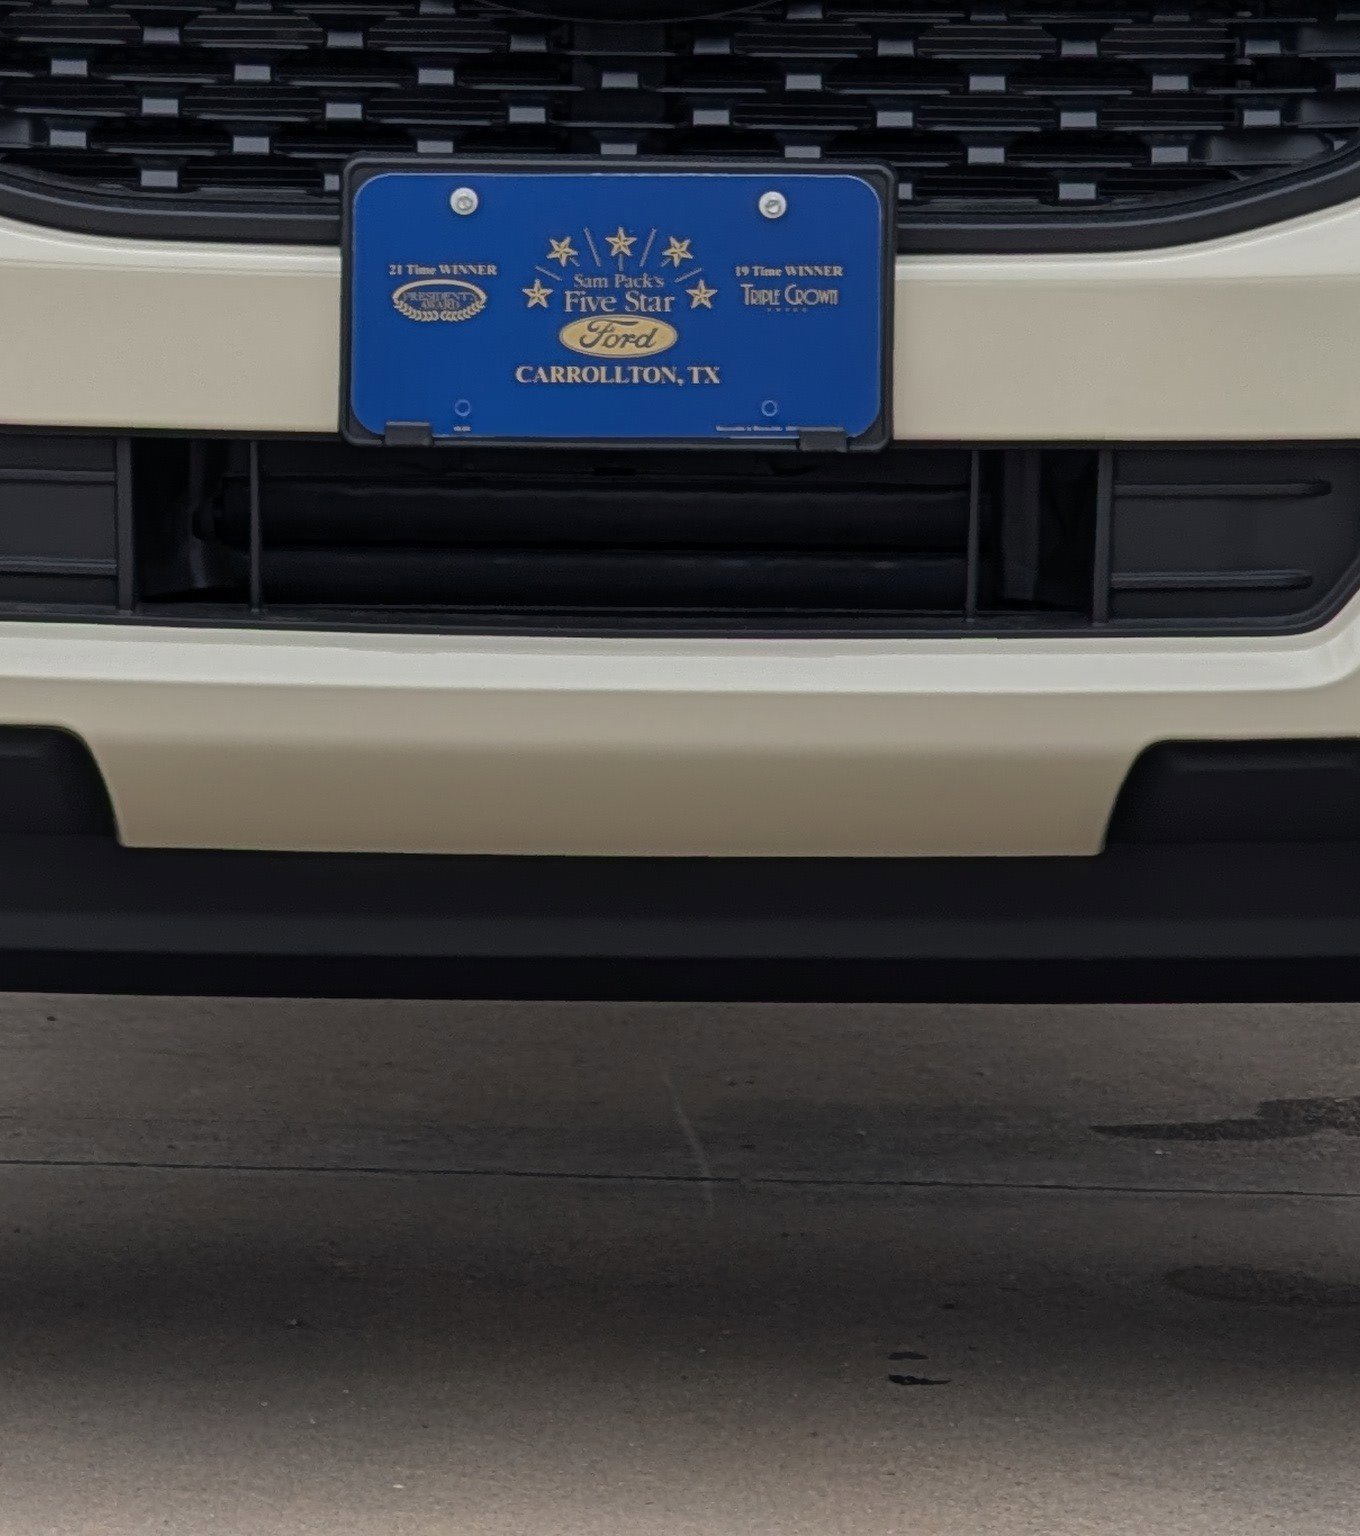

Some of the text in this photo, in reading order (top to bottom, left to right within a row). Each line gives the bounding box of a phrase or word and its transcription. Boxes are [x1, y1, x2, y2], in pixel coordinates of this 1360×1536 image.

[406, 263, 437, 276] Time
[438, 263, 498, 276] WINNER
[752, 265, 783, 277] Time
[784, 265, 844, 277] WINNER
[573, 272, 665, 290] Sam Pack's
[563, 289, 676, 313] Five Star
[740, 283, 839, 306] TRIPLE CROWN
[578, 318, 660, 349] Ford
[515, 366, 721, 387] CARROLLTON, TX
